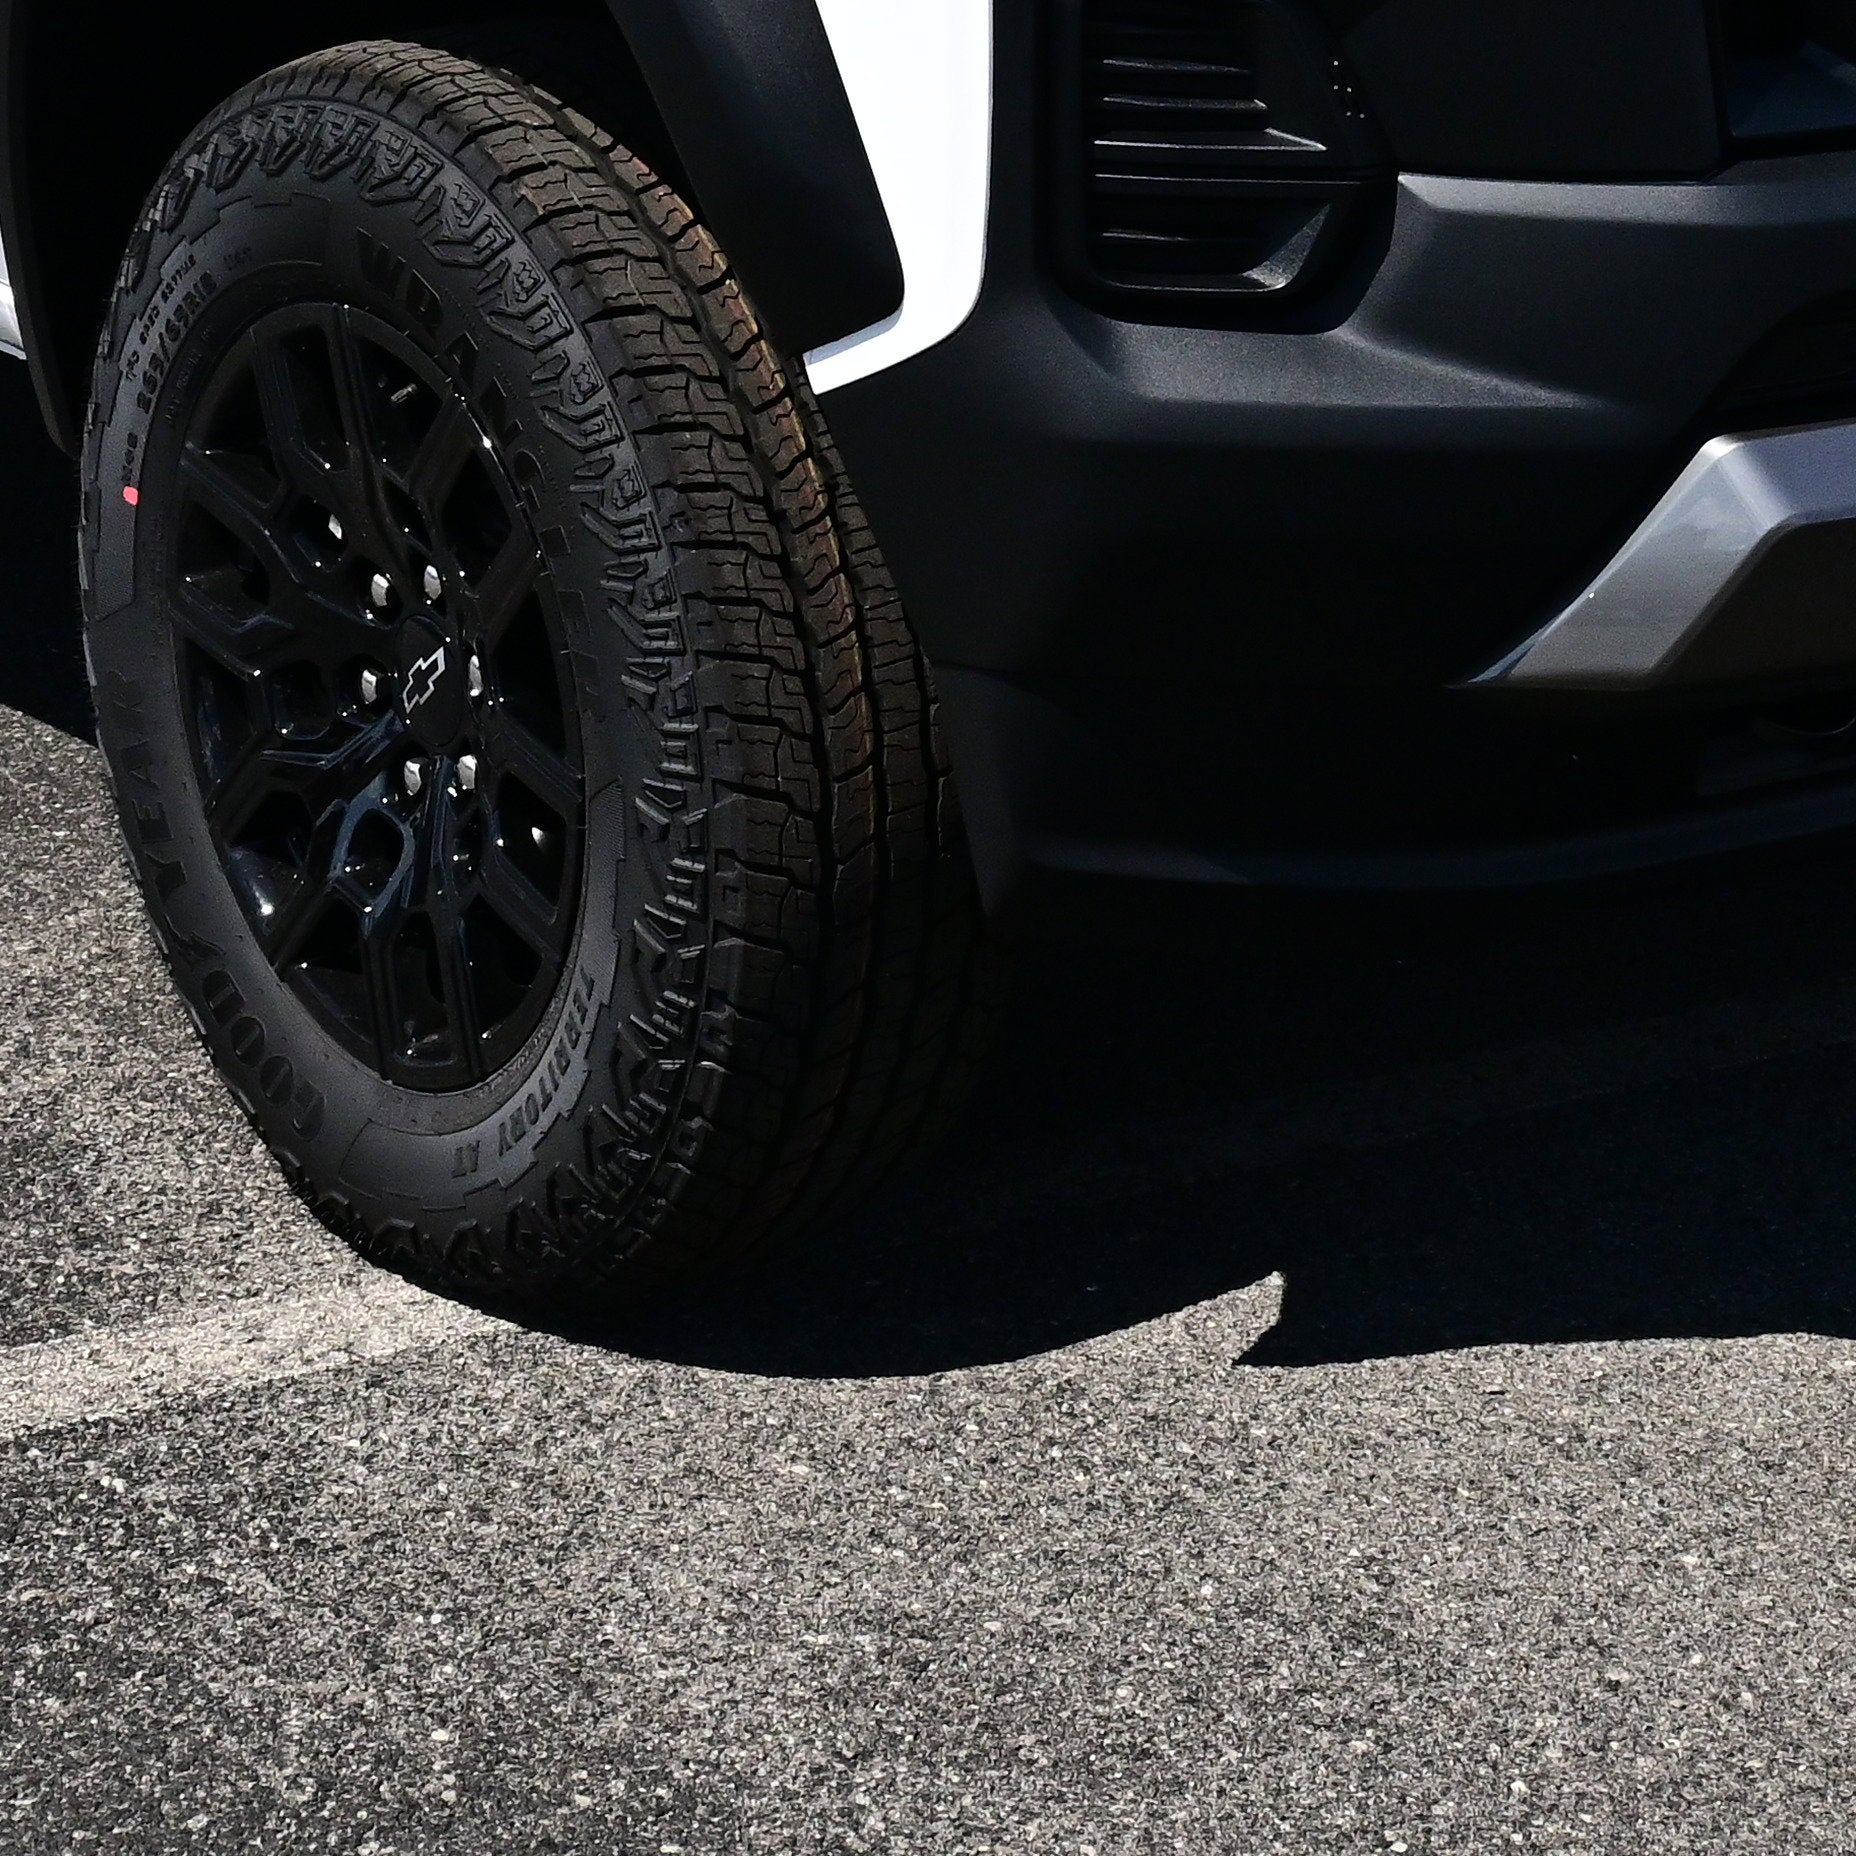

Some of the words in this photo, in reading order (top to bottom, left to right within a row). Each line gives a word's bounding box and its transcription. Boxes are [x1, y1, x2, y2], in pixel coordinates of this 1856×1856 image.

[136, 270, 218, 415] 265/65R18
[499, 964, 595, 1158] TERRITORY
[450, 1139, 480, 1179] AT
